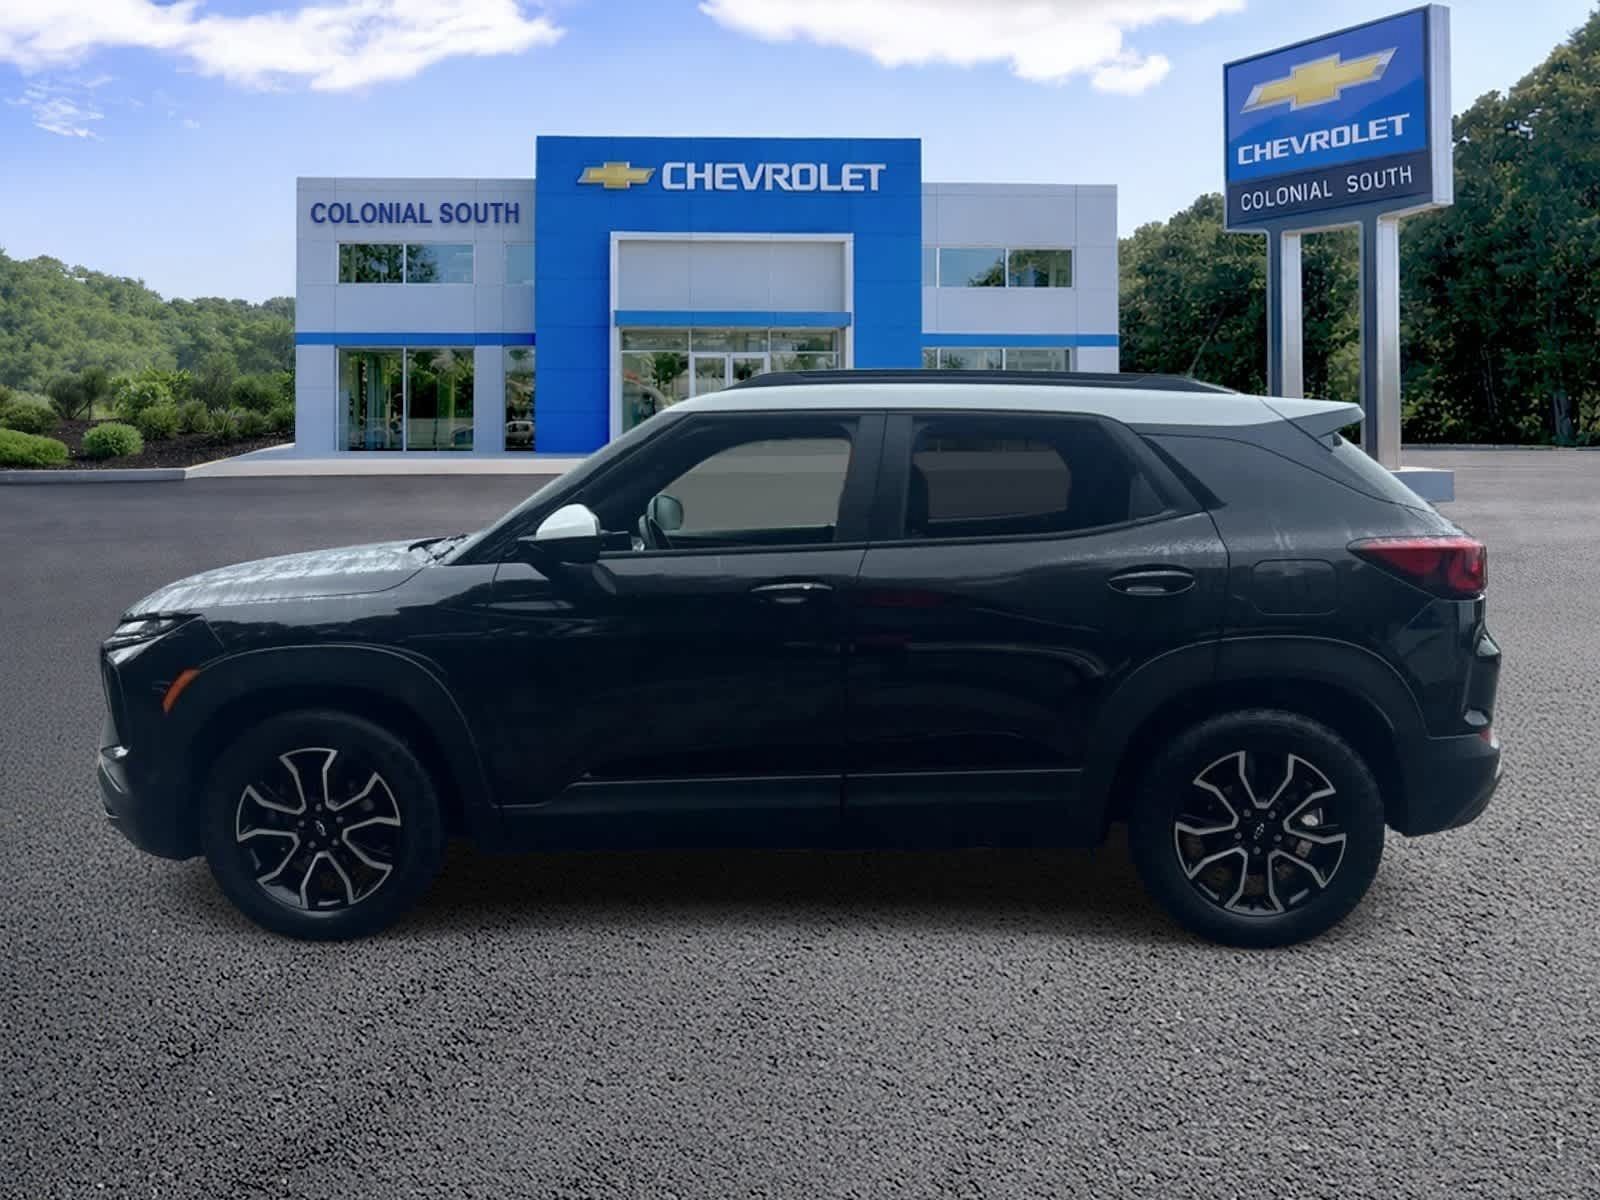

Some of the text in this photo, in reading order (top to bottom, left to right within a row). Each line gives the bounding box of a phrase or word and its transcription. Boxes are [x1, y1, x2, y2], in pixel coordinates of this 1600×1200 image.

[1238, 113, 1410, 165] CHEVROLET
[662, 162, 886, 191] CHEVROLET
[1241, 165, 1412, 211] COLONIAL SOUTH
[311, 202, 520, 224] COLONIAL SOUTH
